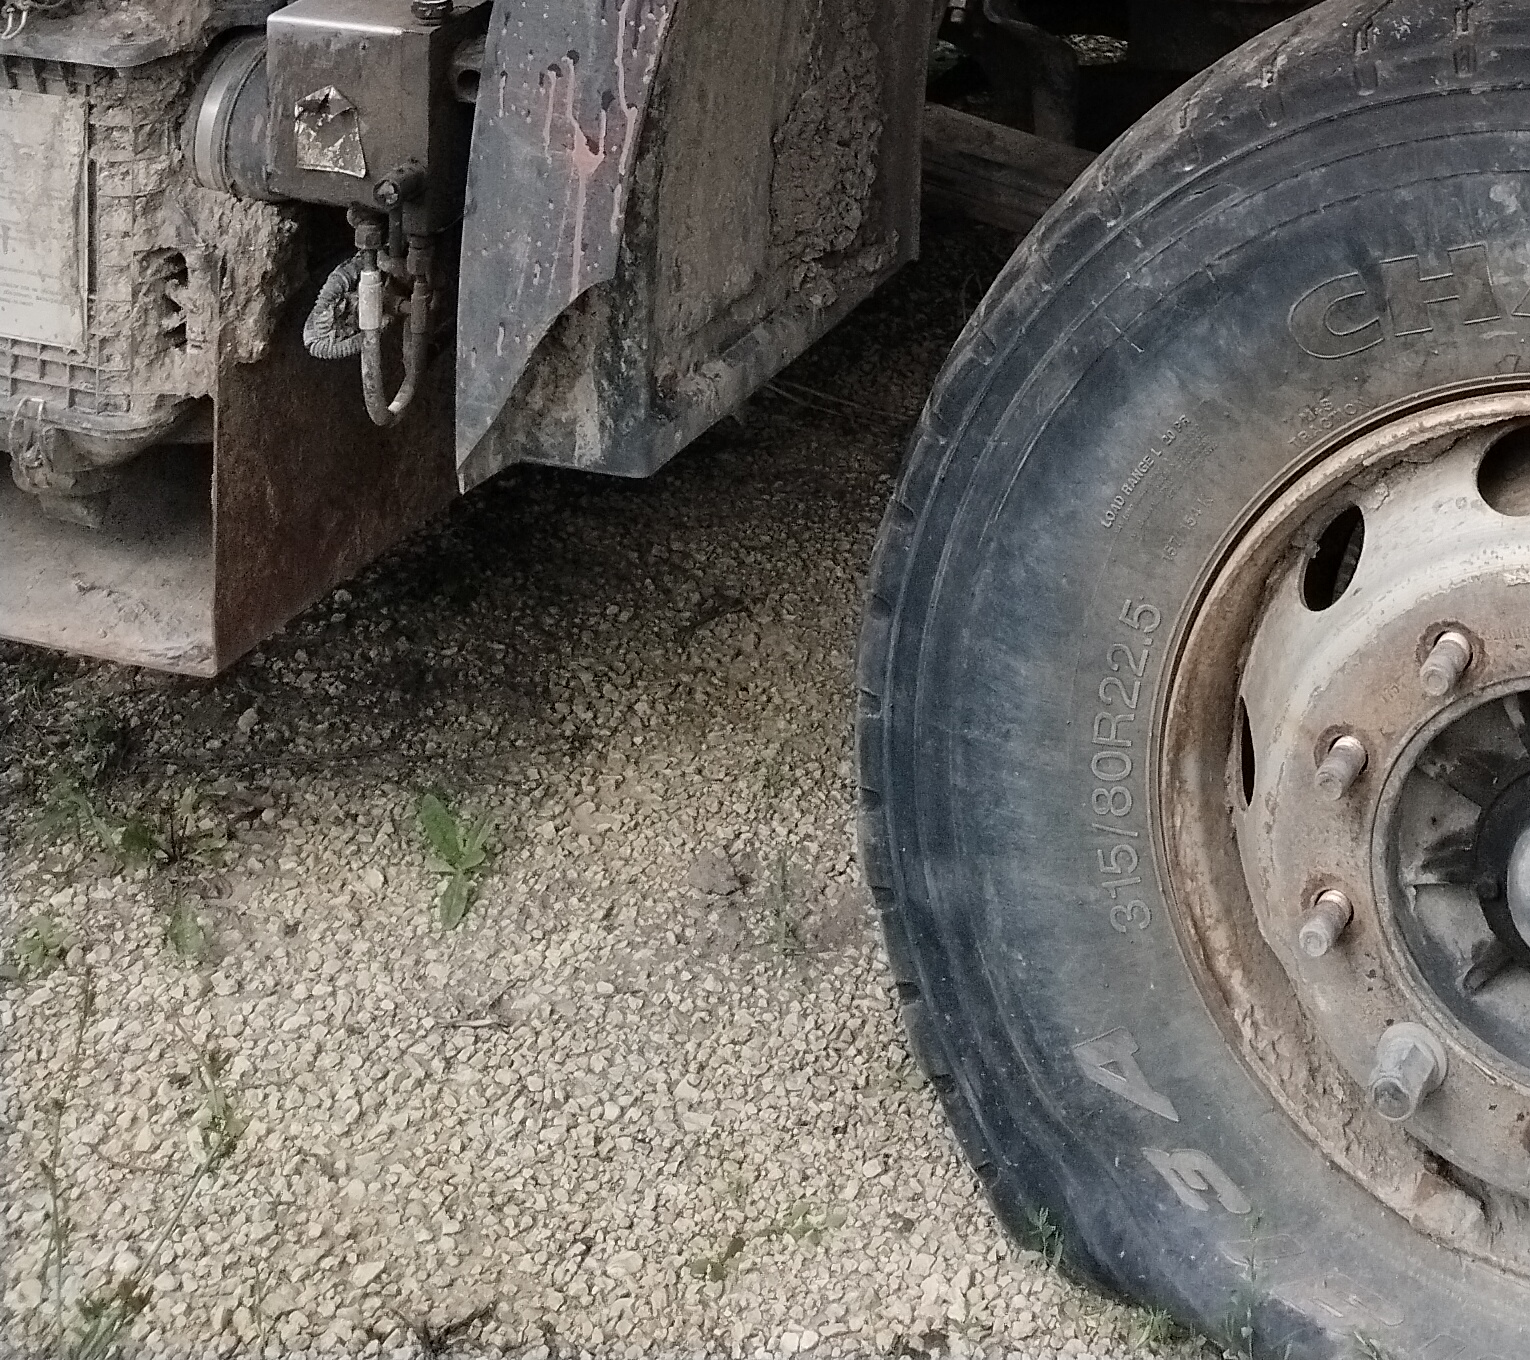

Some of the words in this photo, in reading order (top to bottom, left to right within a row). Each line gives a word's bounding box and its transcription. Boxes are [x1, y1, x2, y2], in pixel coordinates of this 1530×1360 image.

[1098, 493, 1127, 528] LOAD
[1119, 453, 1155, 496] RANGE
[1090, 595, 1163, 935] 315/80R22.5
